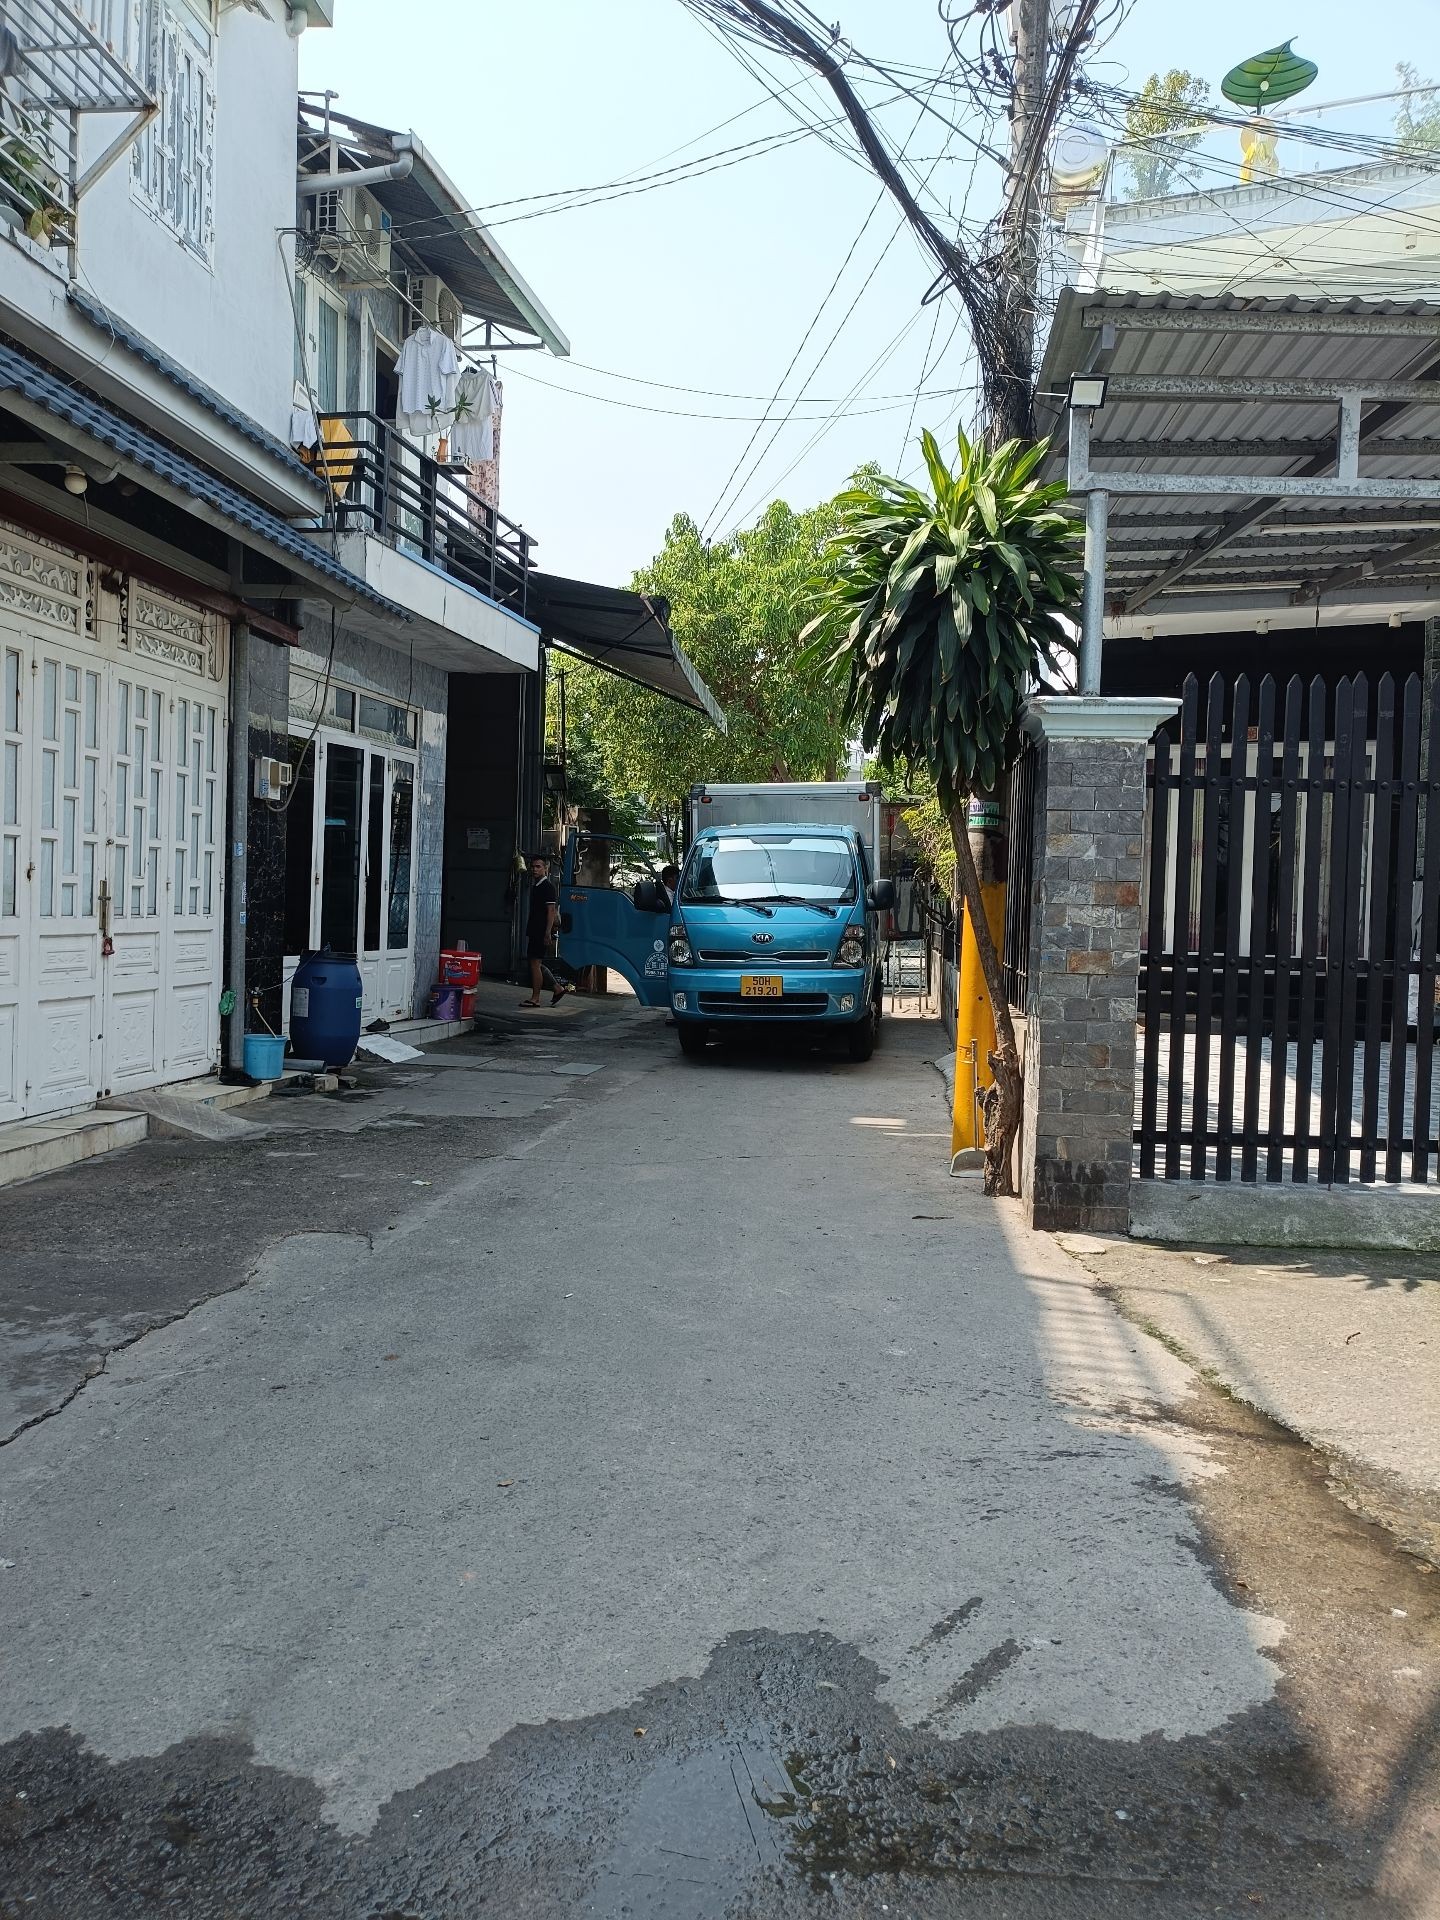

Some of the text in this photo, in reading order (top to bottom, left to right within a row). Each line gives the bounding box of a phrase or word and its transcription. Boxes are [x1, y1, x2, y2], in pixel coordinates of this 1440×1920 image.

[755, 934, 770, 942] KIA
[752, 976, 771, 986] 50H
[745, 986, 778, 996] 219.20
